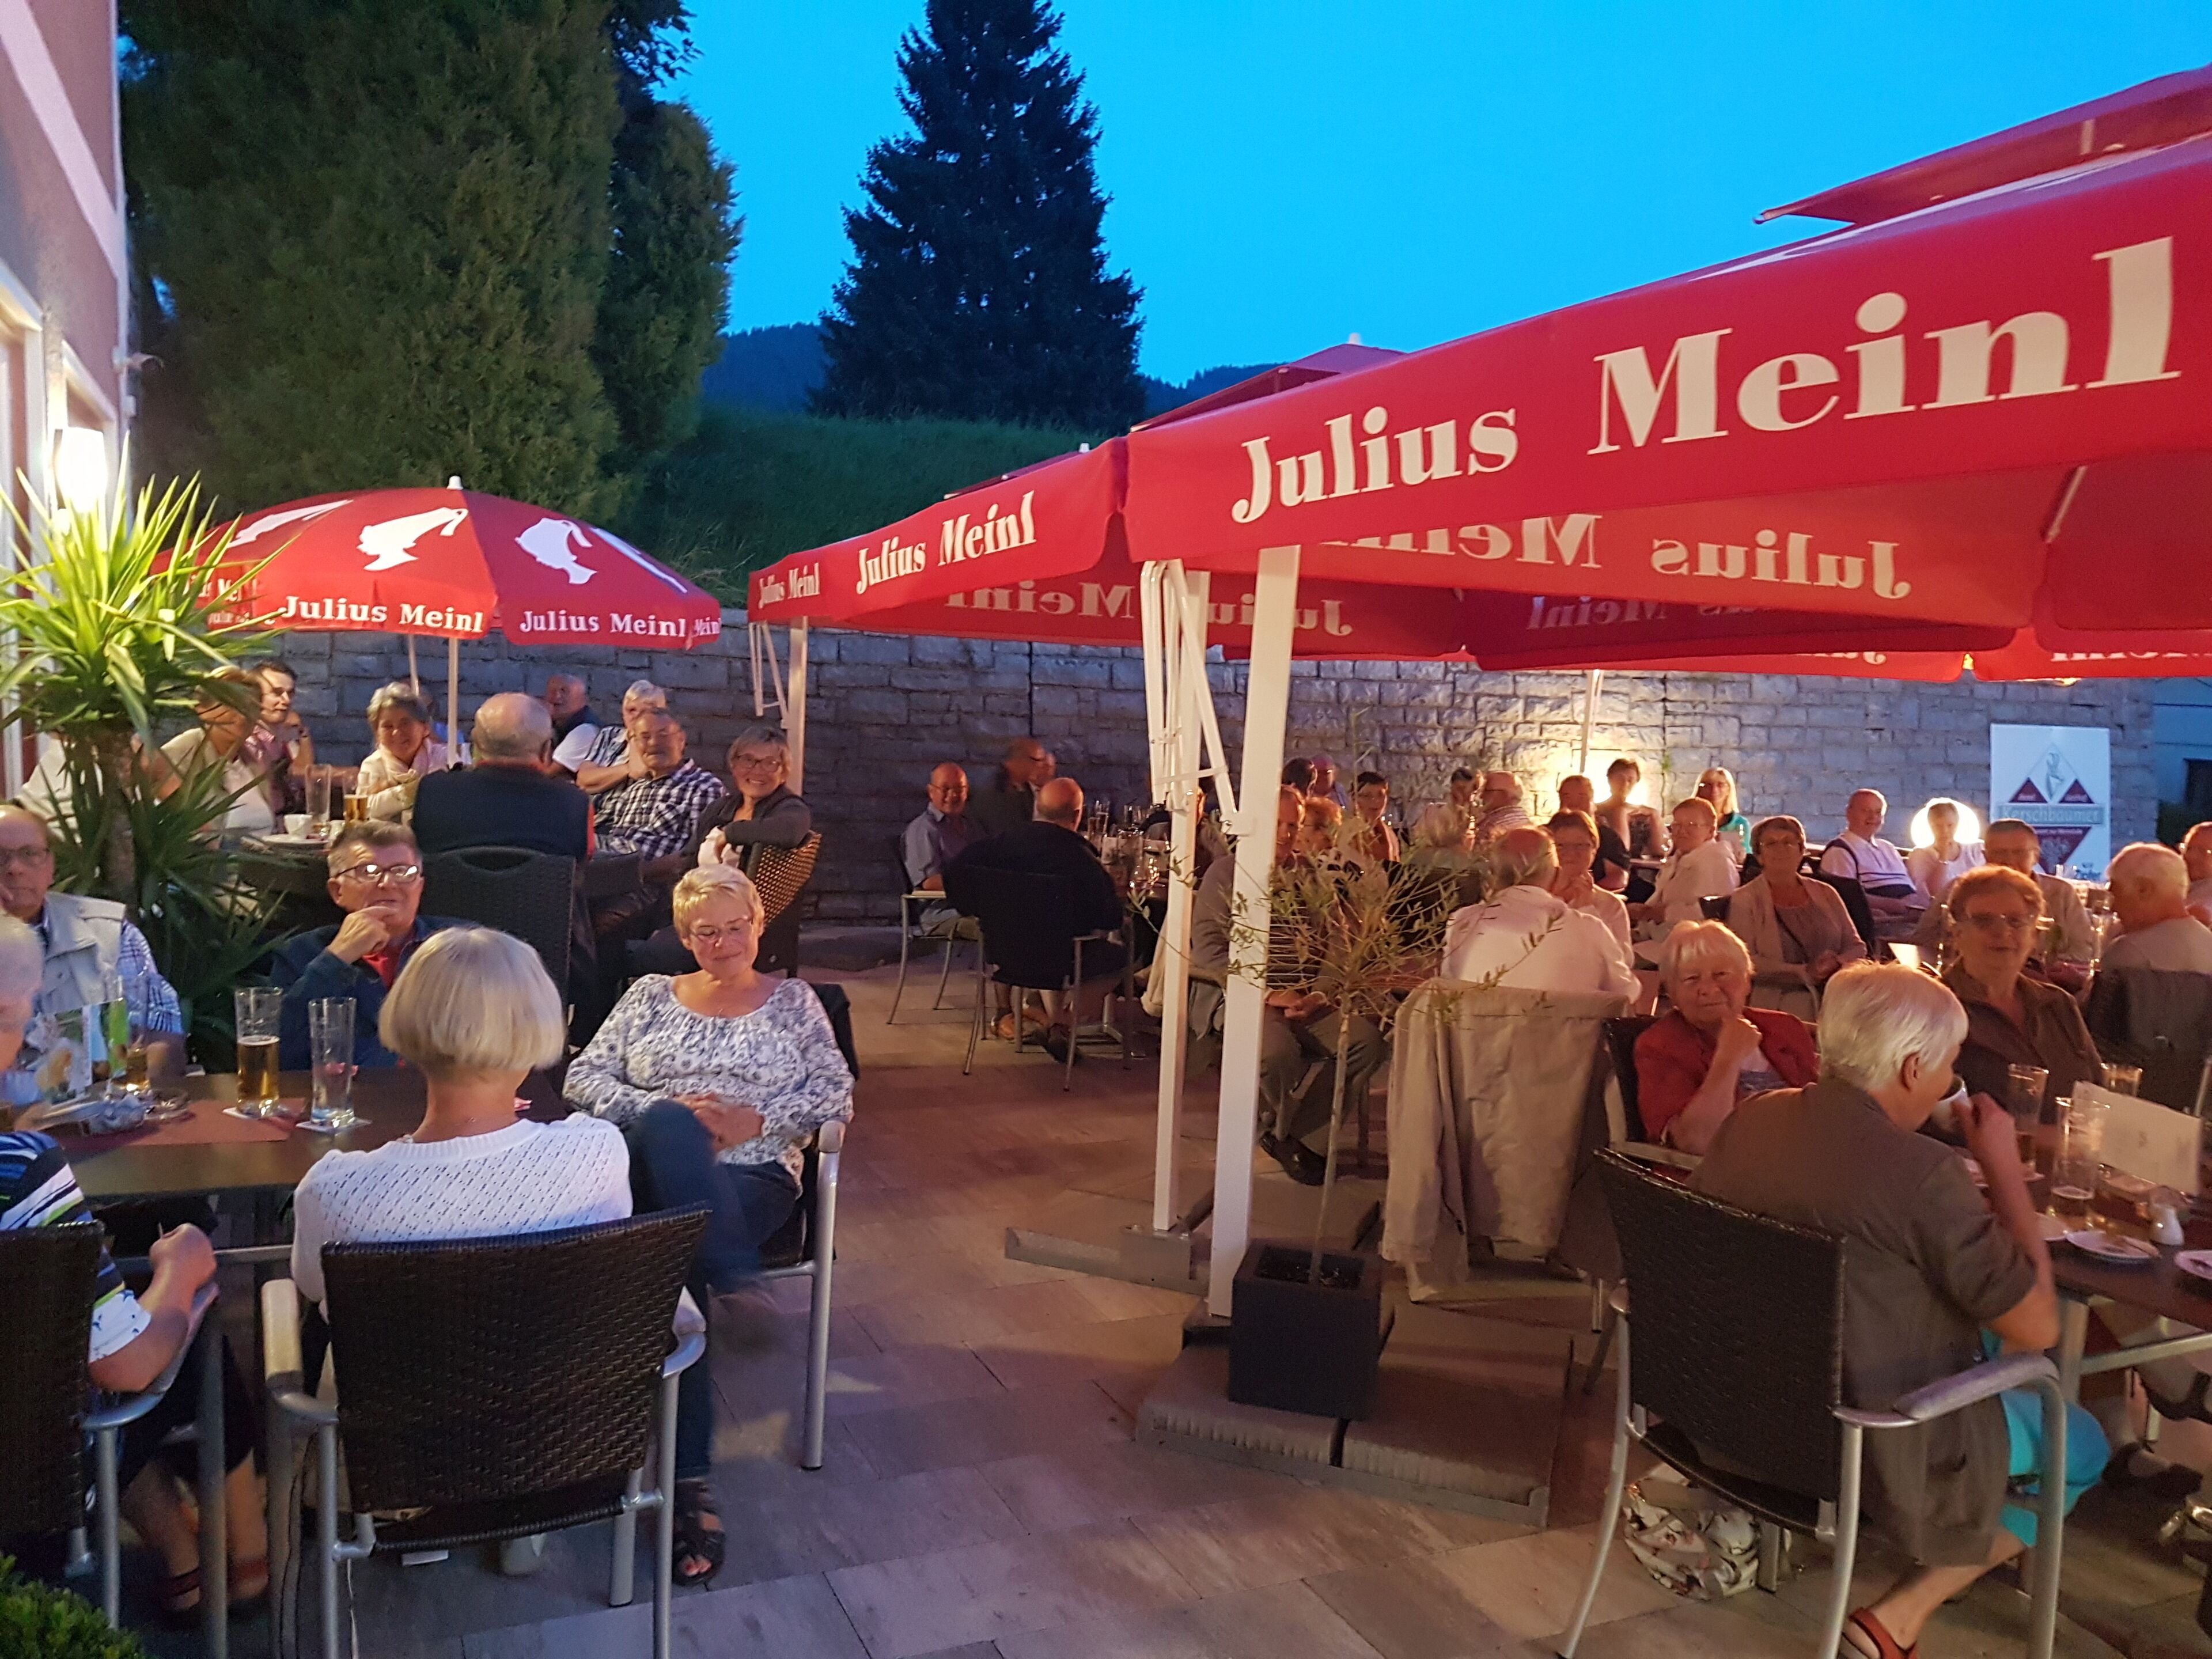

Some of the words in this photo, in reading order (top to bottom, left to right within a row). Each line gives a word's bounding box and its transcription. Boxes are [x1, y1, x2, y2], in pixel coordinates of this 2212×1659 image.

[1231, 406, 1518, 524] Julius
[1587, 236, 2181, 455] Meinl
[856, 536, 926, 594] Julius
[937, 490, 1037, 567] Meinl
[278, 596, 388, 623] Julius
[399, 603, 483, 632] Meinl
[519, 609, 600, 632] Julius
[609, 613, 686, 638] Meinl
